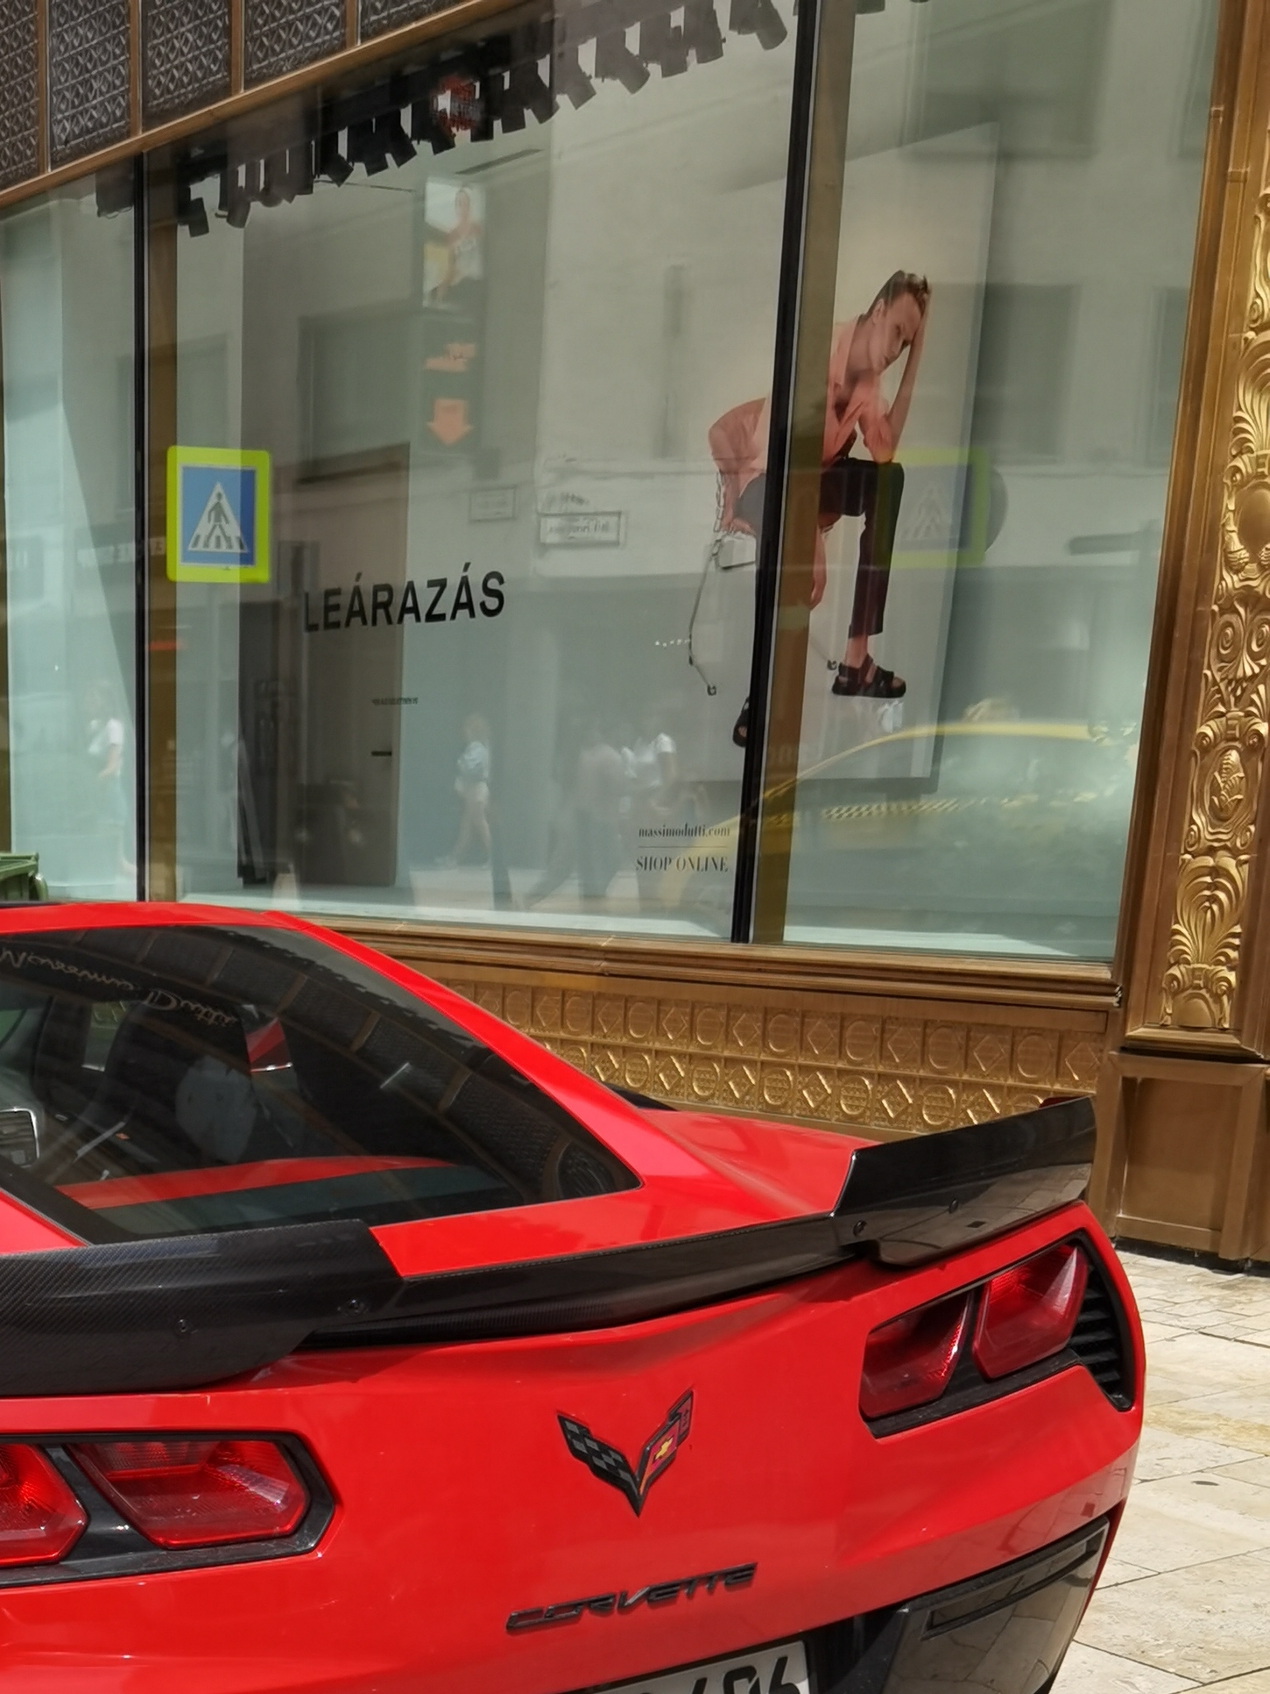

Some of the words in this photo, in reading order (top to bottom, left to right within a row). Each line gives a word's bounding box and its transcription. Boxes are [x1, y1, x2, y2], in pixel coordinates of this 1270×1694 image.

[303, 562, 506, 633] LEÁRAZÁS
[638, 823, 731, 837] massimodutti.com
[636, 856, 672, 872] SHOP
[676, 857, 729, 873] ONLINE
[505, 1562, 758, 1634] CORVETTE
